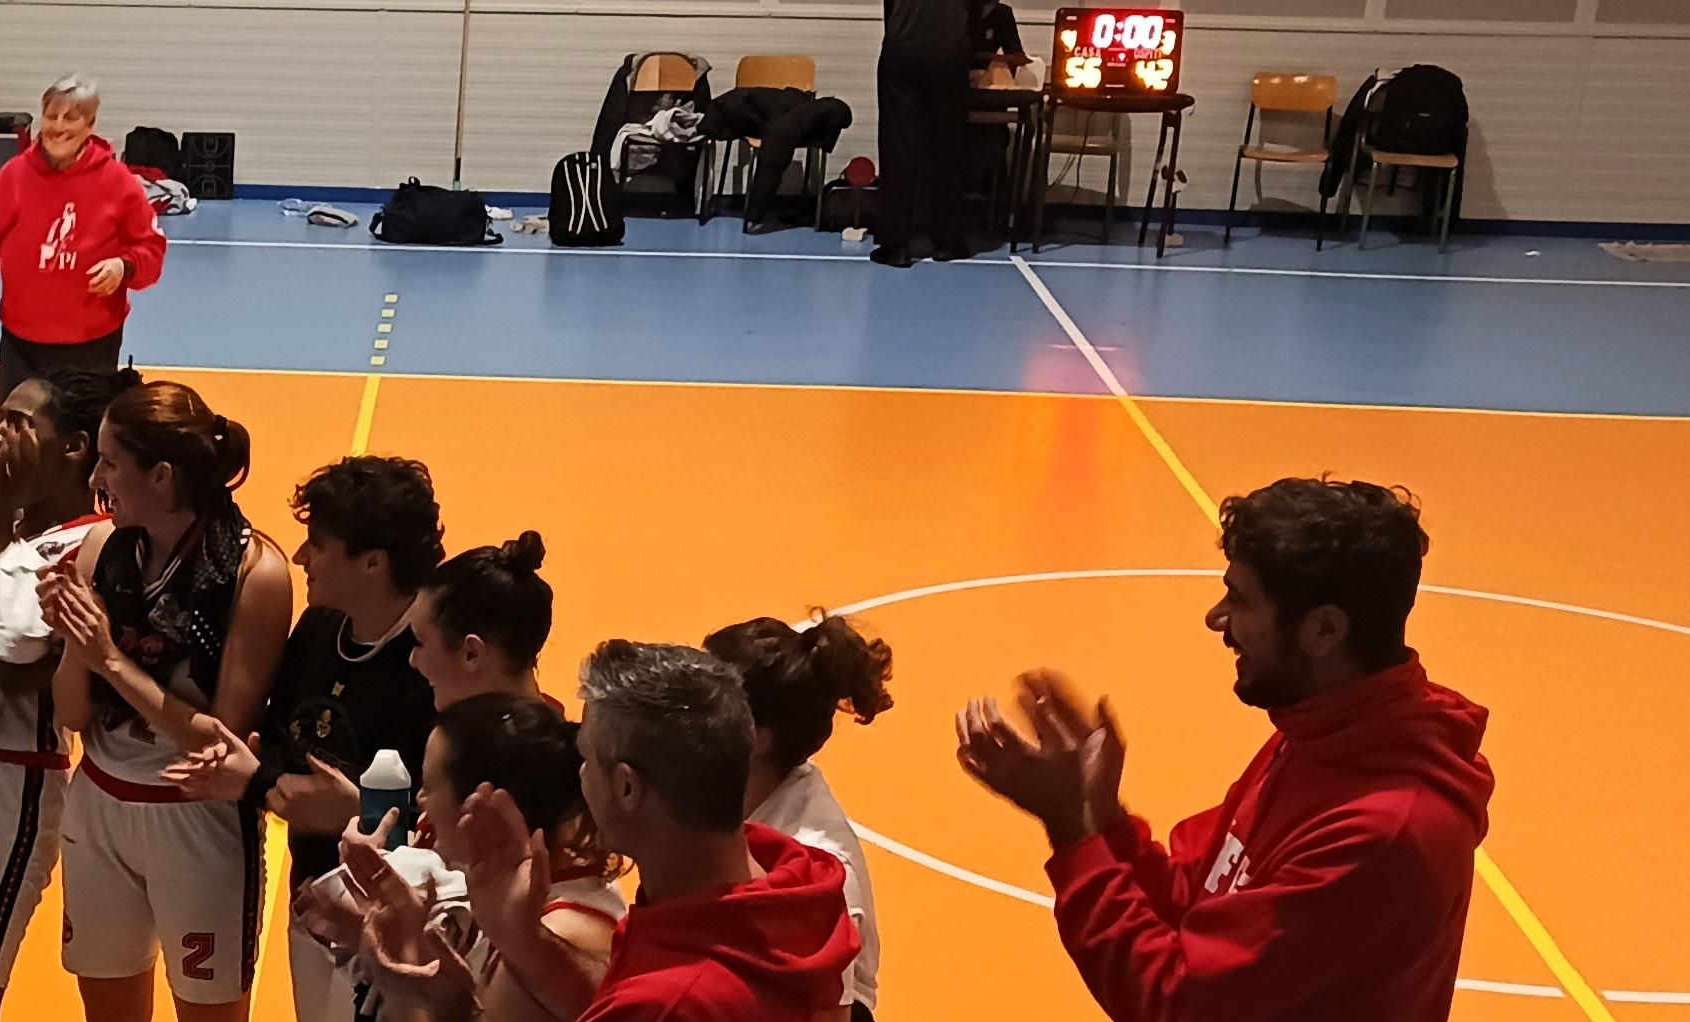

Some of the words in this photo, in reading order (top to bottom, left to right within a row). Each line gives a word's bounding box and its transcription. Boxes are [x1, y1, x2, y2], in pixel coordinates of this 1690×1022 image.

[1092, 14, 1163, 48] 0:00
[1073, 47, 1102, 58] CASA
[1065, 57, 1103, 88] 56
[1135, 59, 1174, 90] 42
[182, 932, 215, 981] 2
